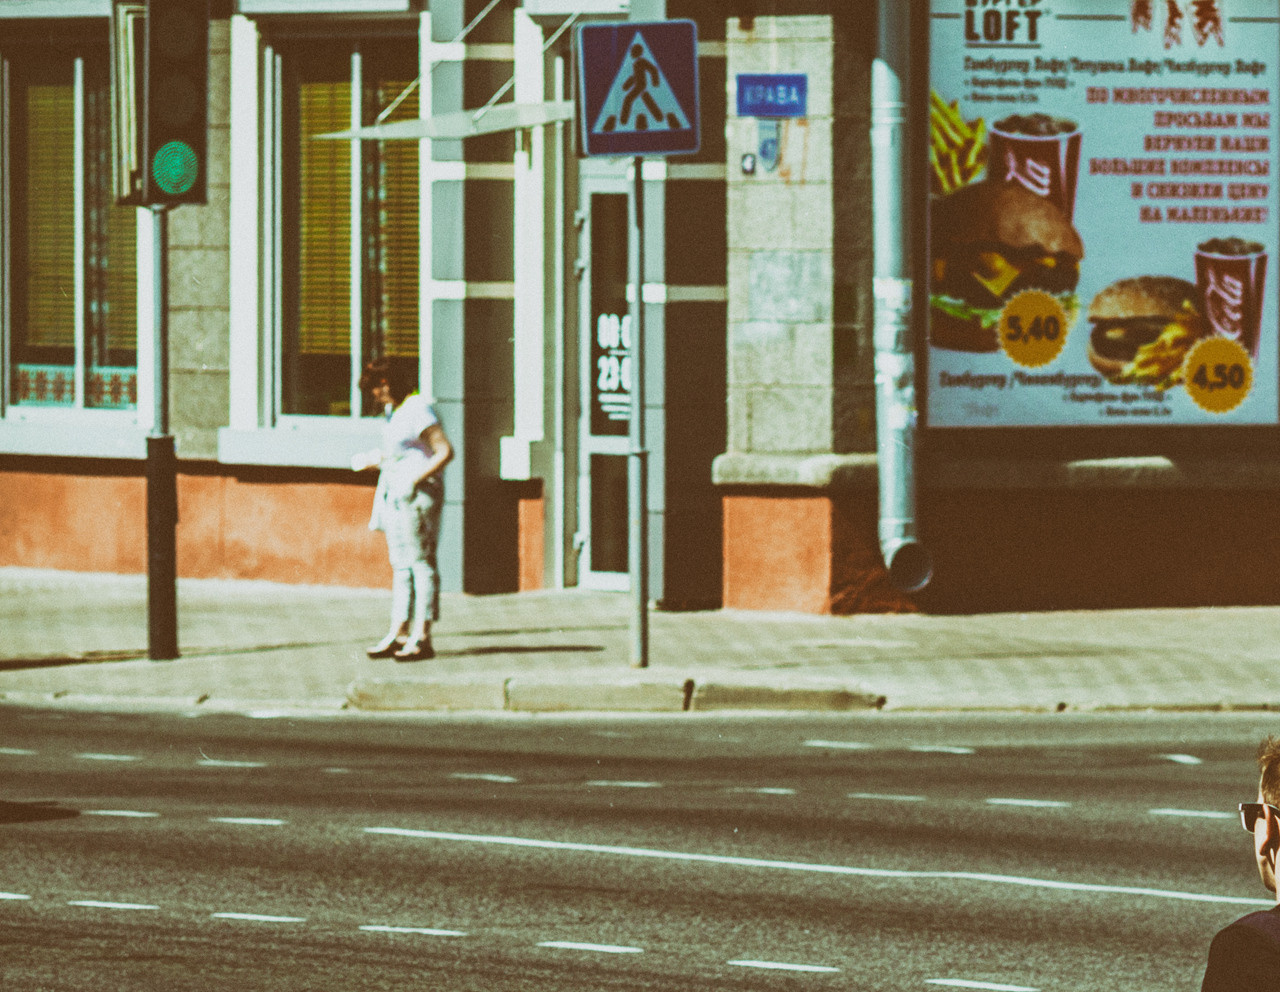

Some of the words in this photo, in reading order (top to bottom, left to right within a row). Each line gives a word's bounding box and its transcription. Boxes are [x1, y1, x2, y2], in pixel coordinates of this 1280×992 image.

[964, 9, 1042, 41] LOFT
[1086, 87, 1109, 104] ПО
[1113, 88, 1270, 105] МНОГОЧИСЛЕННЫМ
[1154, 111, 1238, 128] ПРОСЬБАМ
[1242, 113, 1270, 129] МЫ
[1140, 206, 1162, 223] НА
